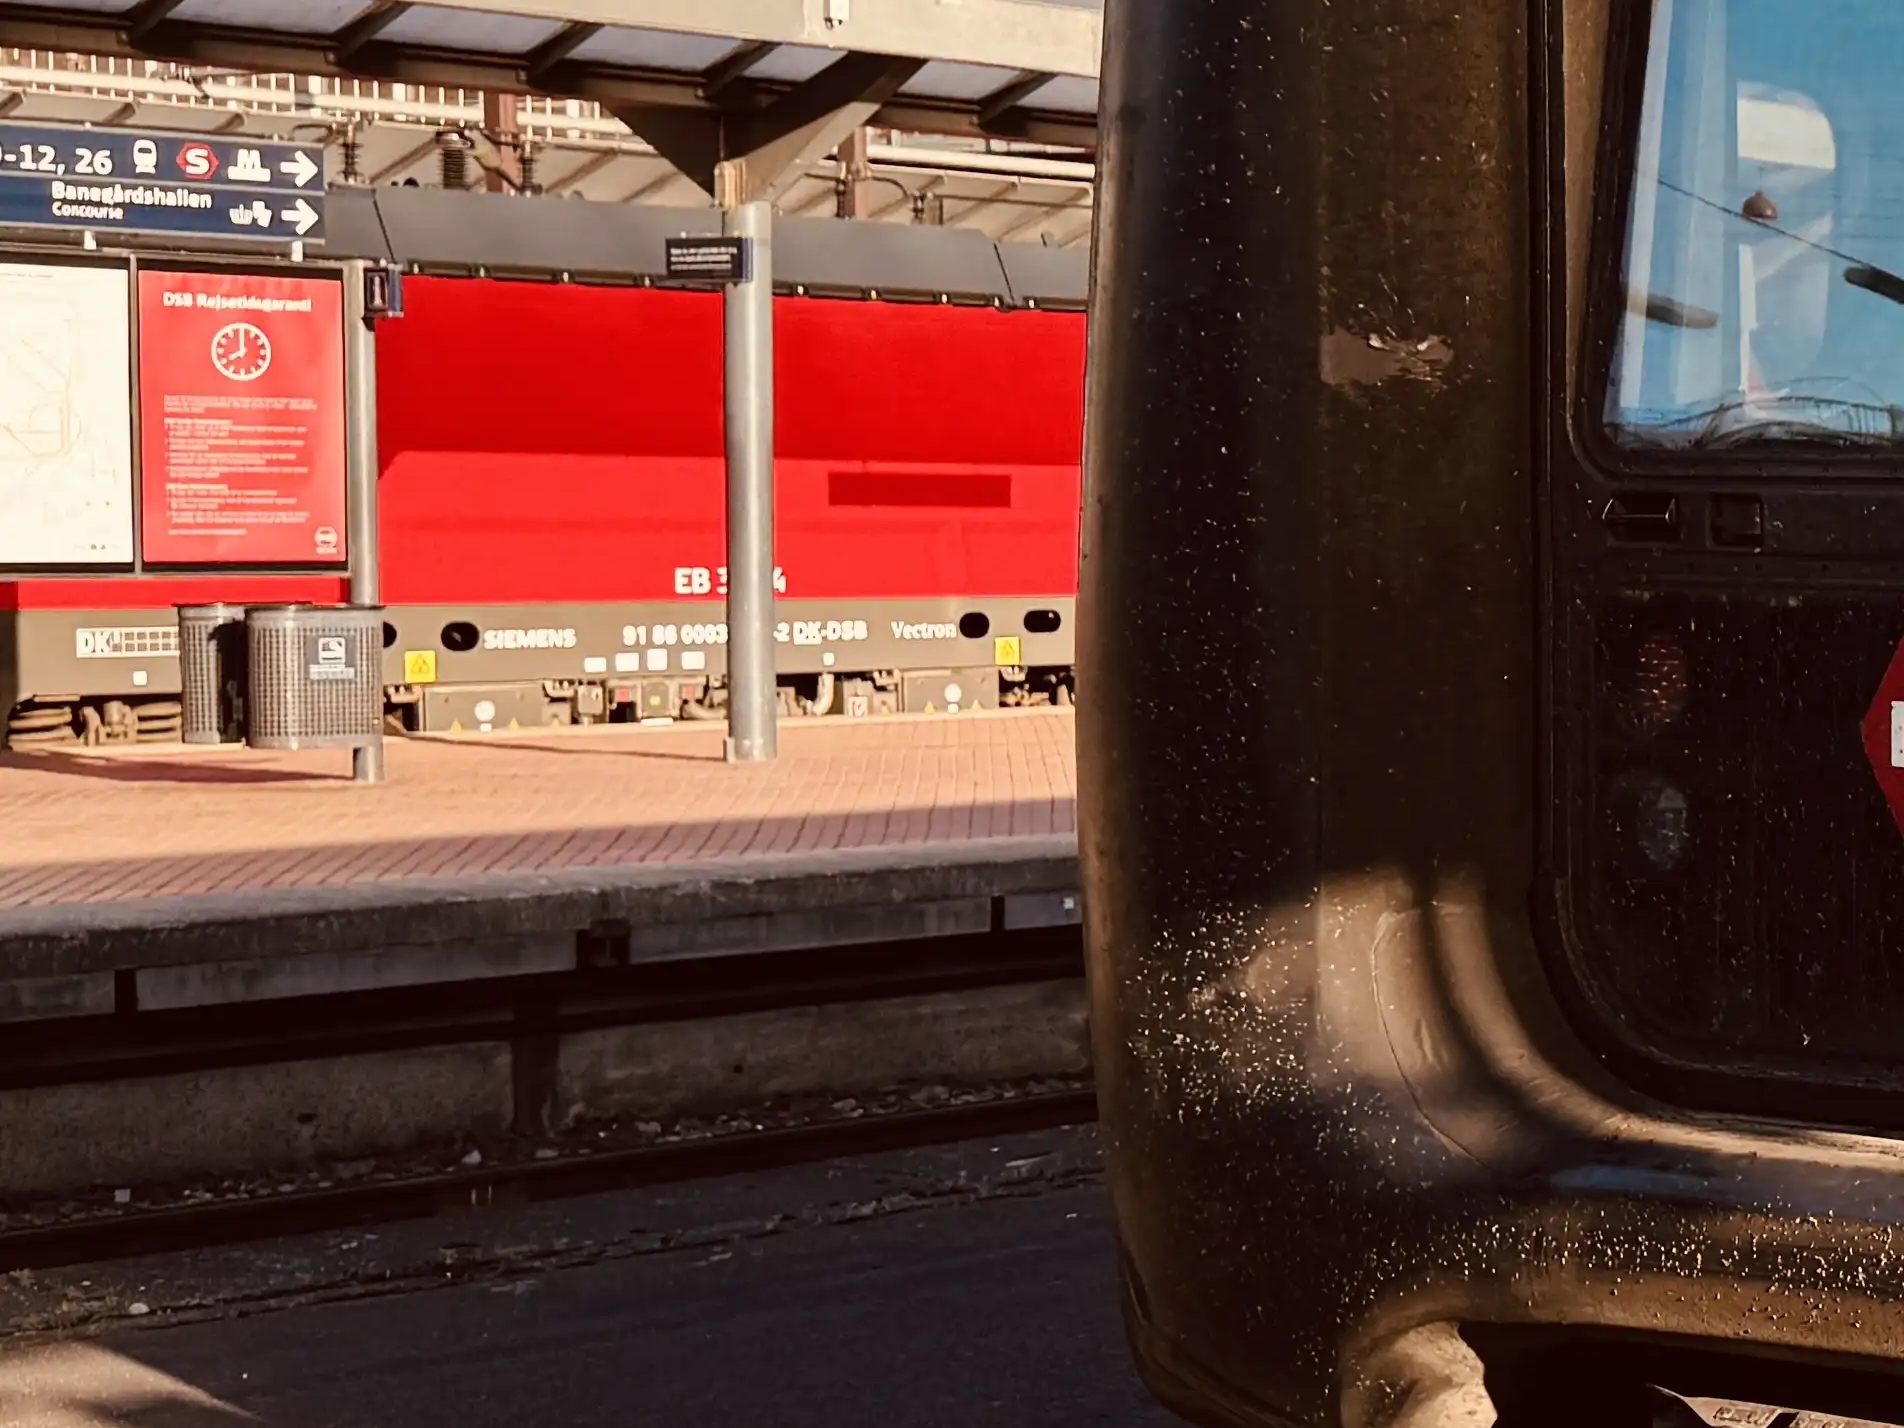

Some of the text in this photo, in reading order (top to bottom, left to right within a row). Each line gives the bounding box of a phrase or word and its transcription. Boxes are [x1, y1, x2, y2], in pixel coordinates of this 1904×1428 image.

[0, 144, 65, 176] -12,
[75, 147, 113, 175] 26
[185, 148, 210, 175] S
[674, 566, 787, 594] EB 34
[484, 628, 577, 649] SIEMENS
[890, 620, 957, 640] Vectron
